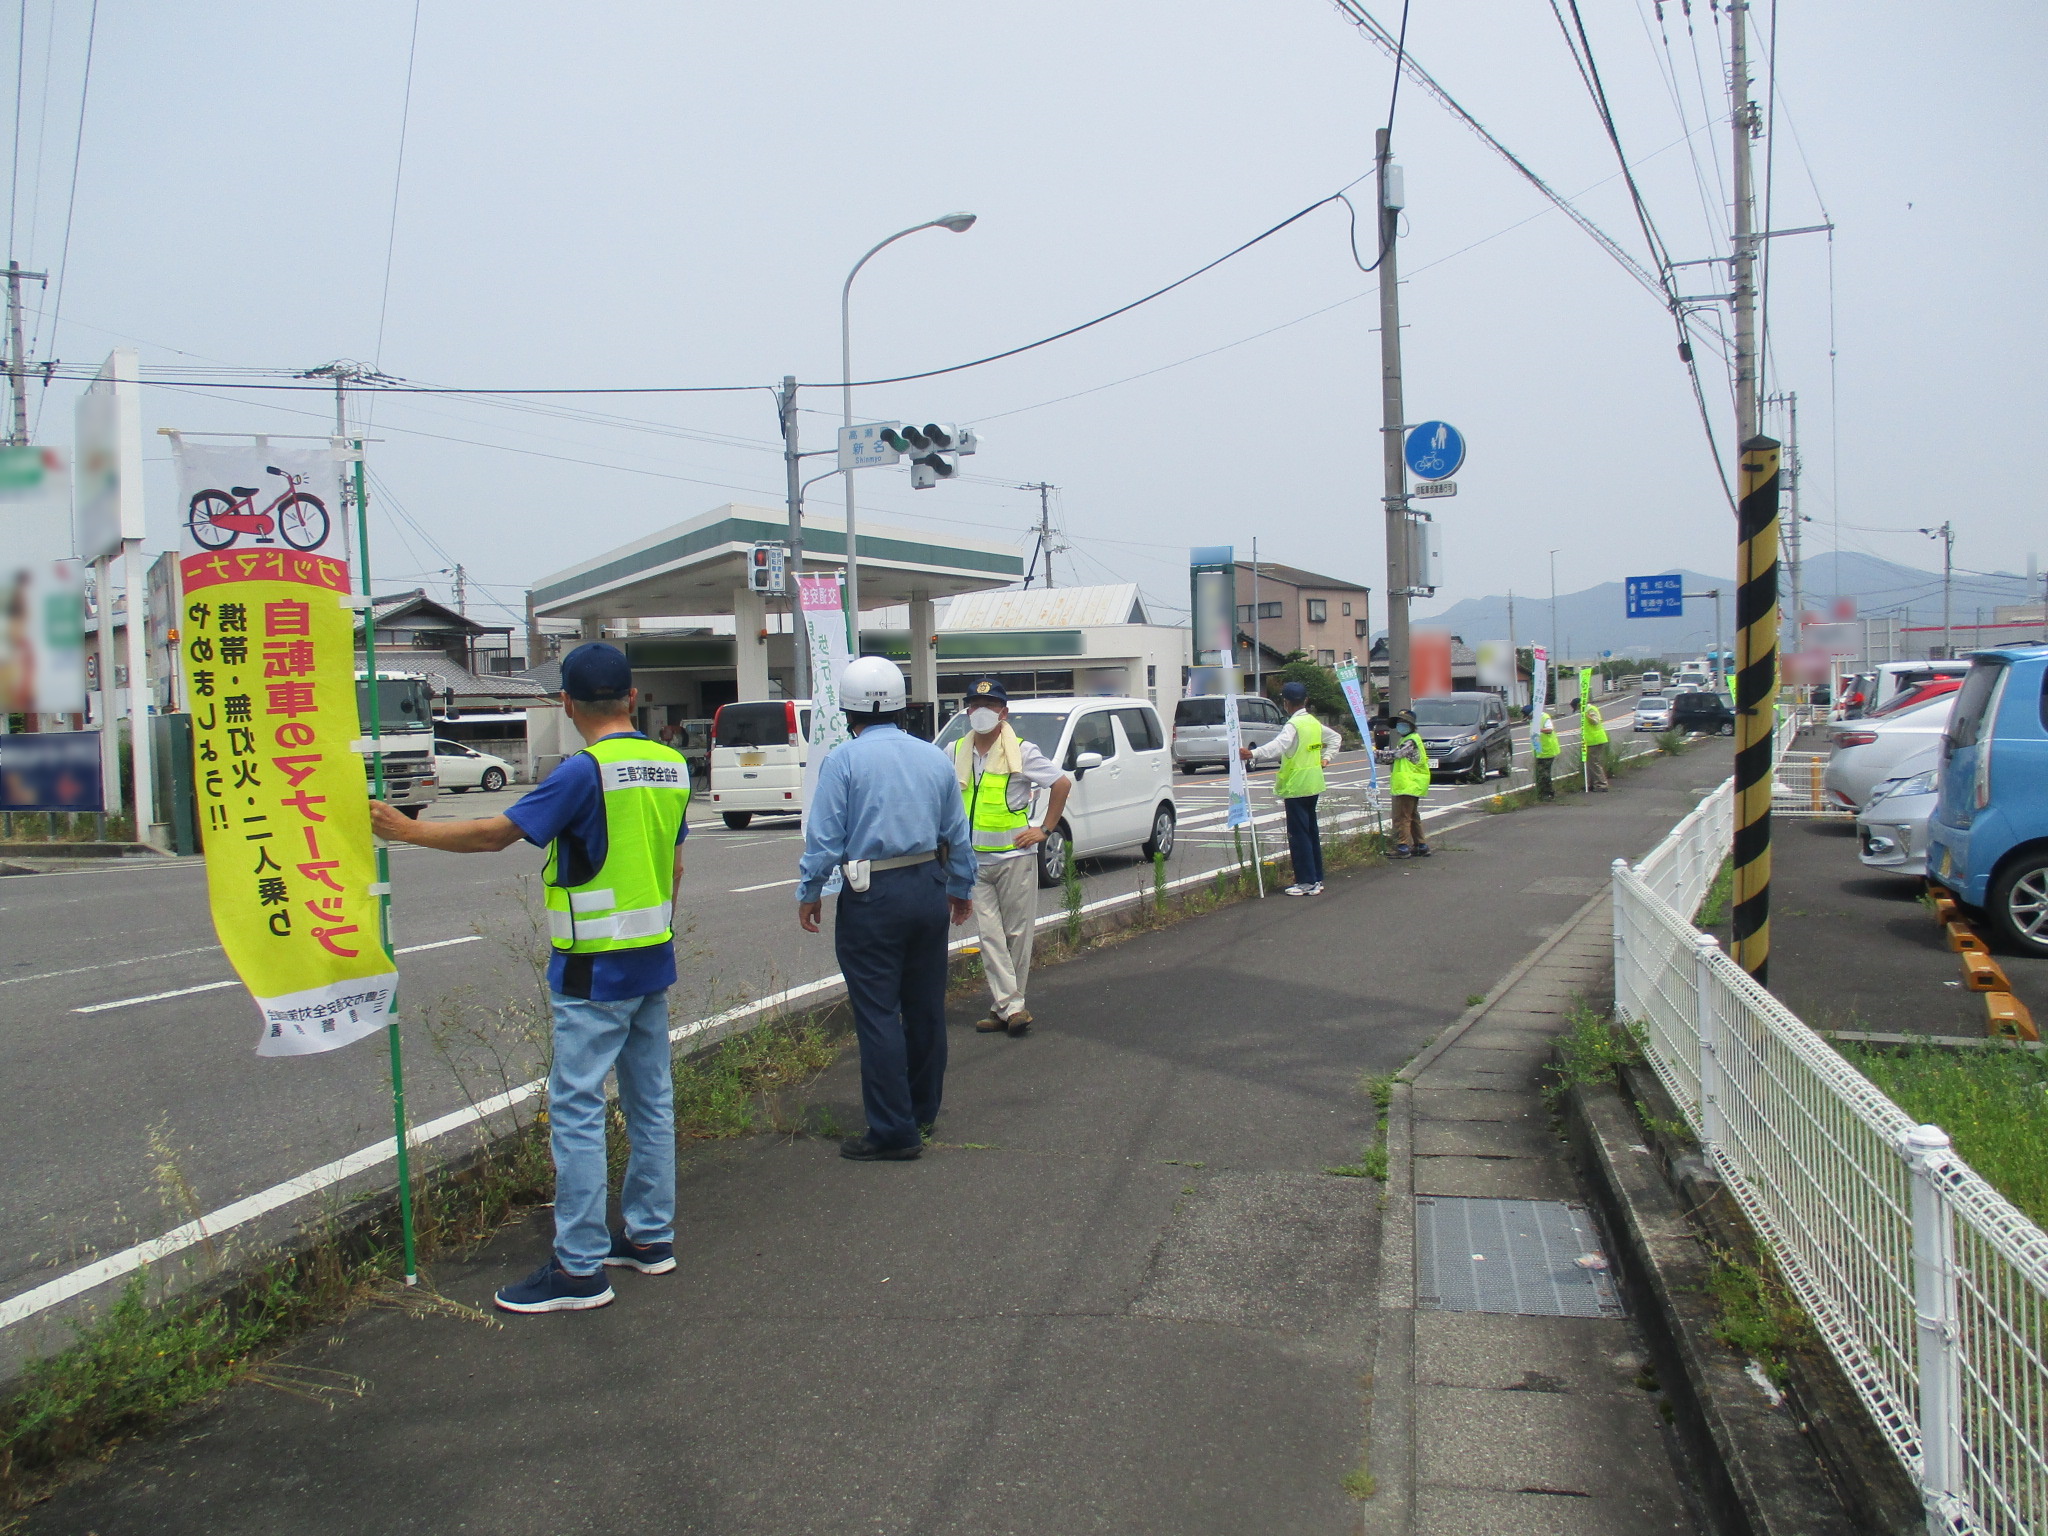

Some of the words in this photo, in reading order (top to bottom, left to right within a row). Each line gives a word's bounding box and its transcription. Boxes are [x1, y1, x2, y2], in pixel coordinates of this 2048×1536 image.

[852, 440, 885, 456] 新名
[855, 456, 882, 465] Shinmyo
[616, 766, 679, 783] 三豊交通安全協会
